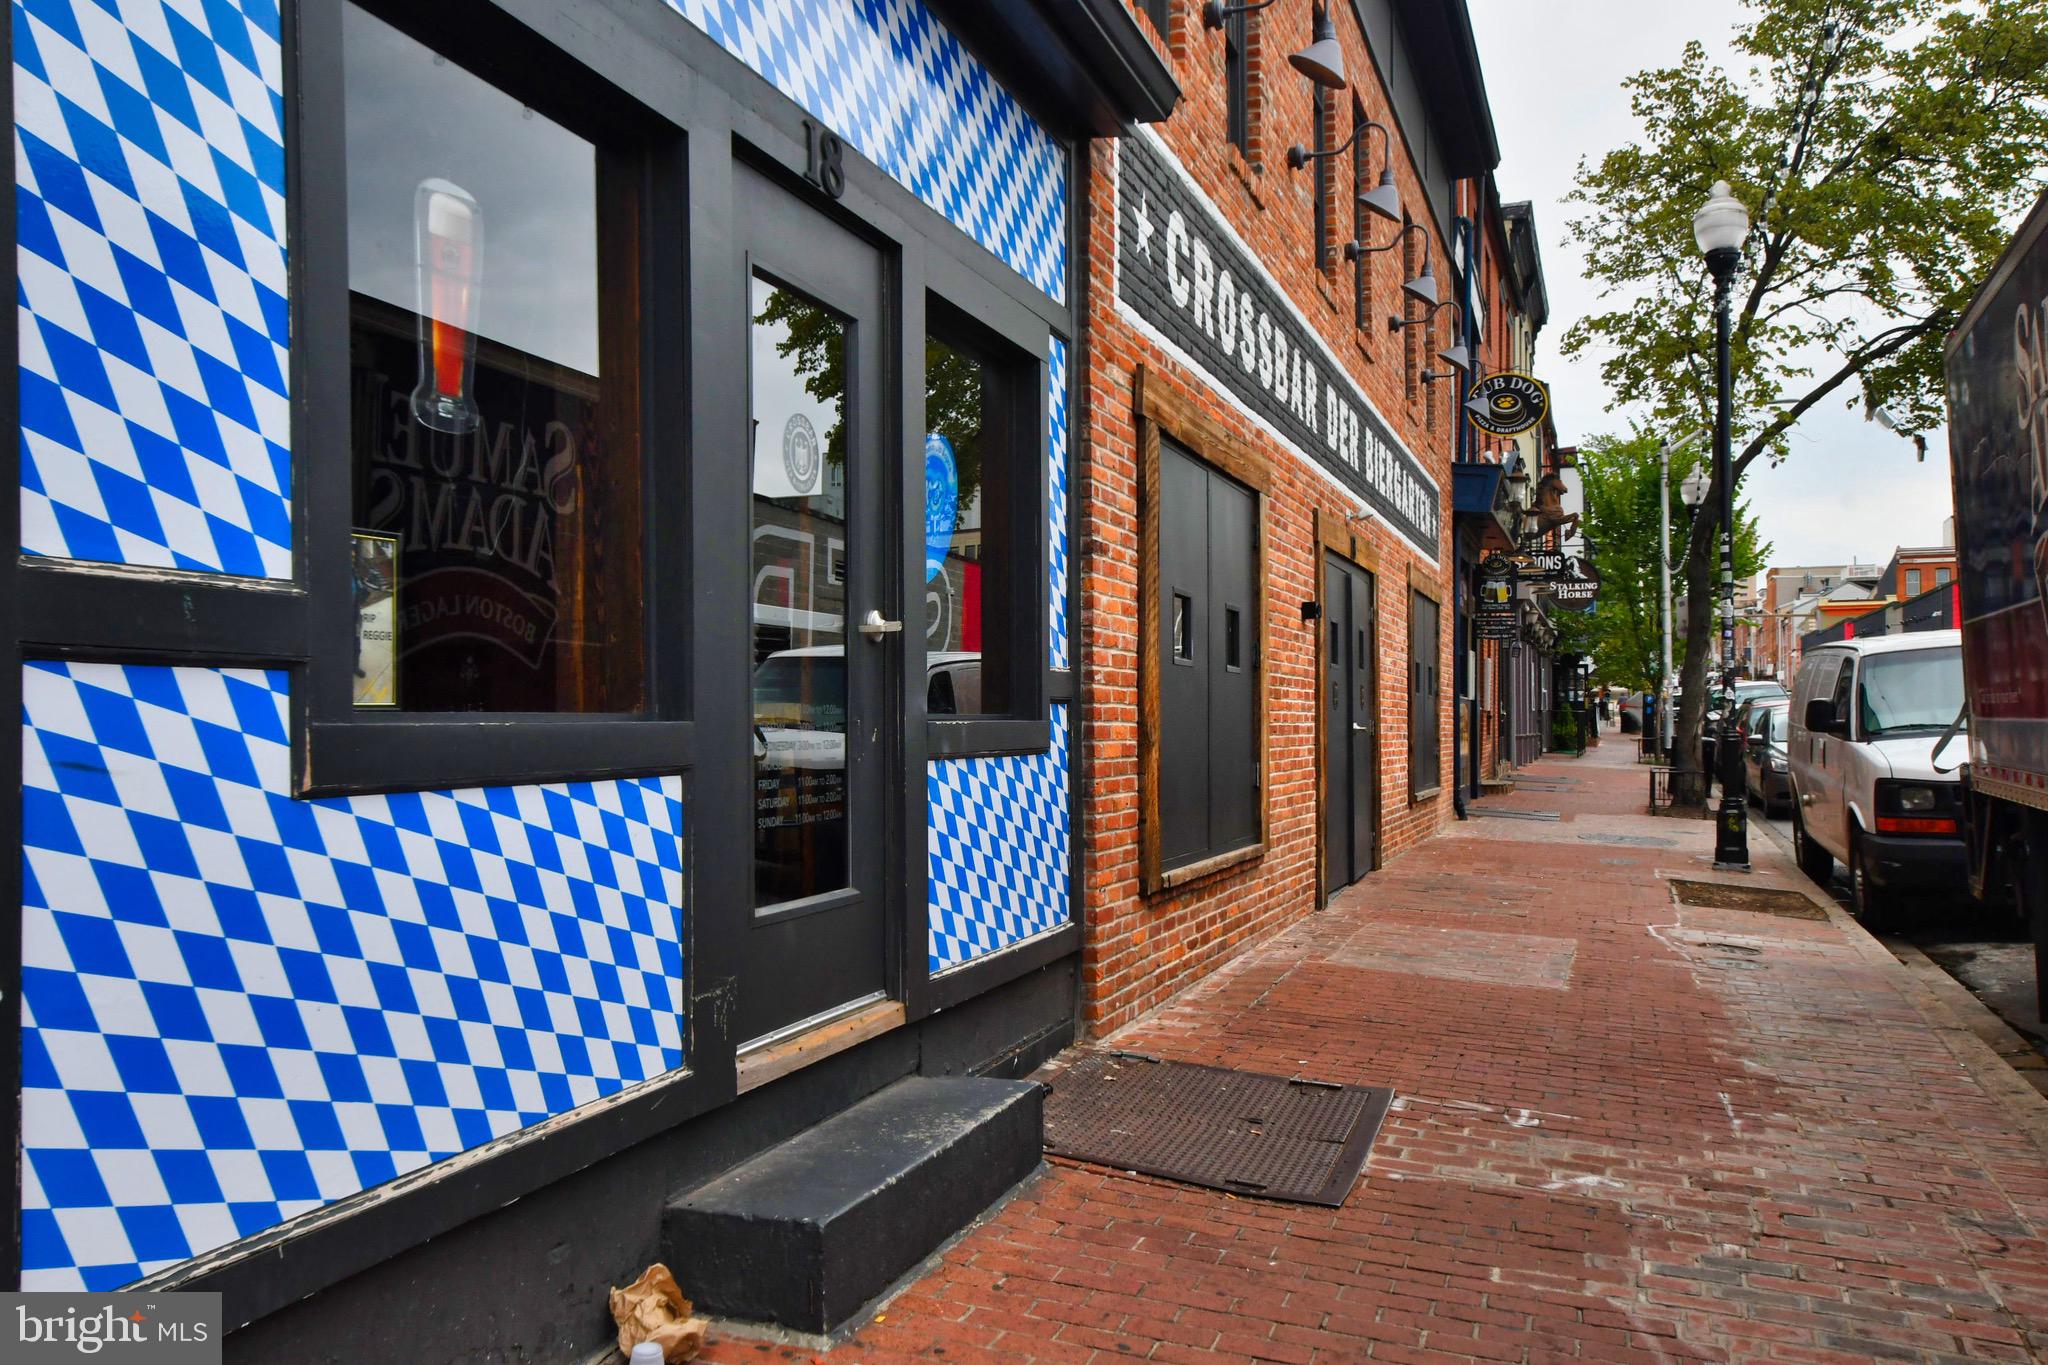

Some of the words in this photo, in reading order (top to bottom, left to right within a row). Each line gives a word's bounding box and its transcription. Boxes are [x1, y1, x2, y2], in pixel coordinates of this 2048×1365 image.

[802, 119, 845, 199] 18
[1166, 210, 1318, 435] CROSSBAR
[1326, 384, 1360, 473] DER
[1364, 426, 1432, 539] BIERGARTEN
[1509, 377, 1544, 404] DOG
[1496, 416, 1537, 433] DRAFTHOUSE
[1549, 581, 1598, 591] STALKING
[1558, 590, 1593, 599] HORSE
[362, 630, 392, 641] REGGIE
[758, 779, 780, 790] FRIDAY
[758, 796, 790, 809] SATURDAY
[758, 816, 784, 829] SUNDAY
